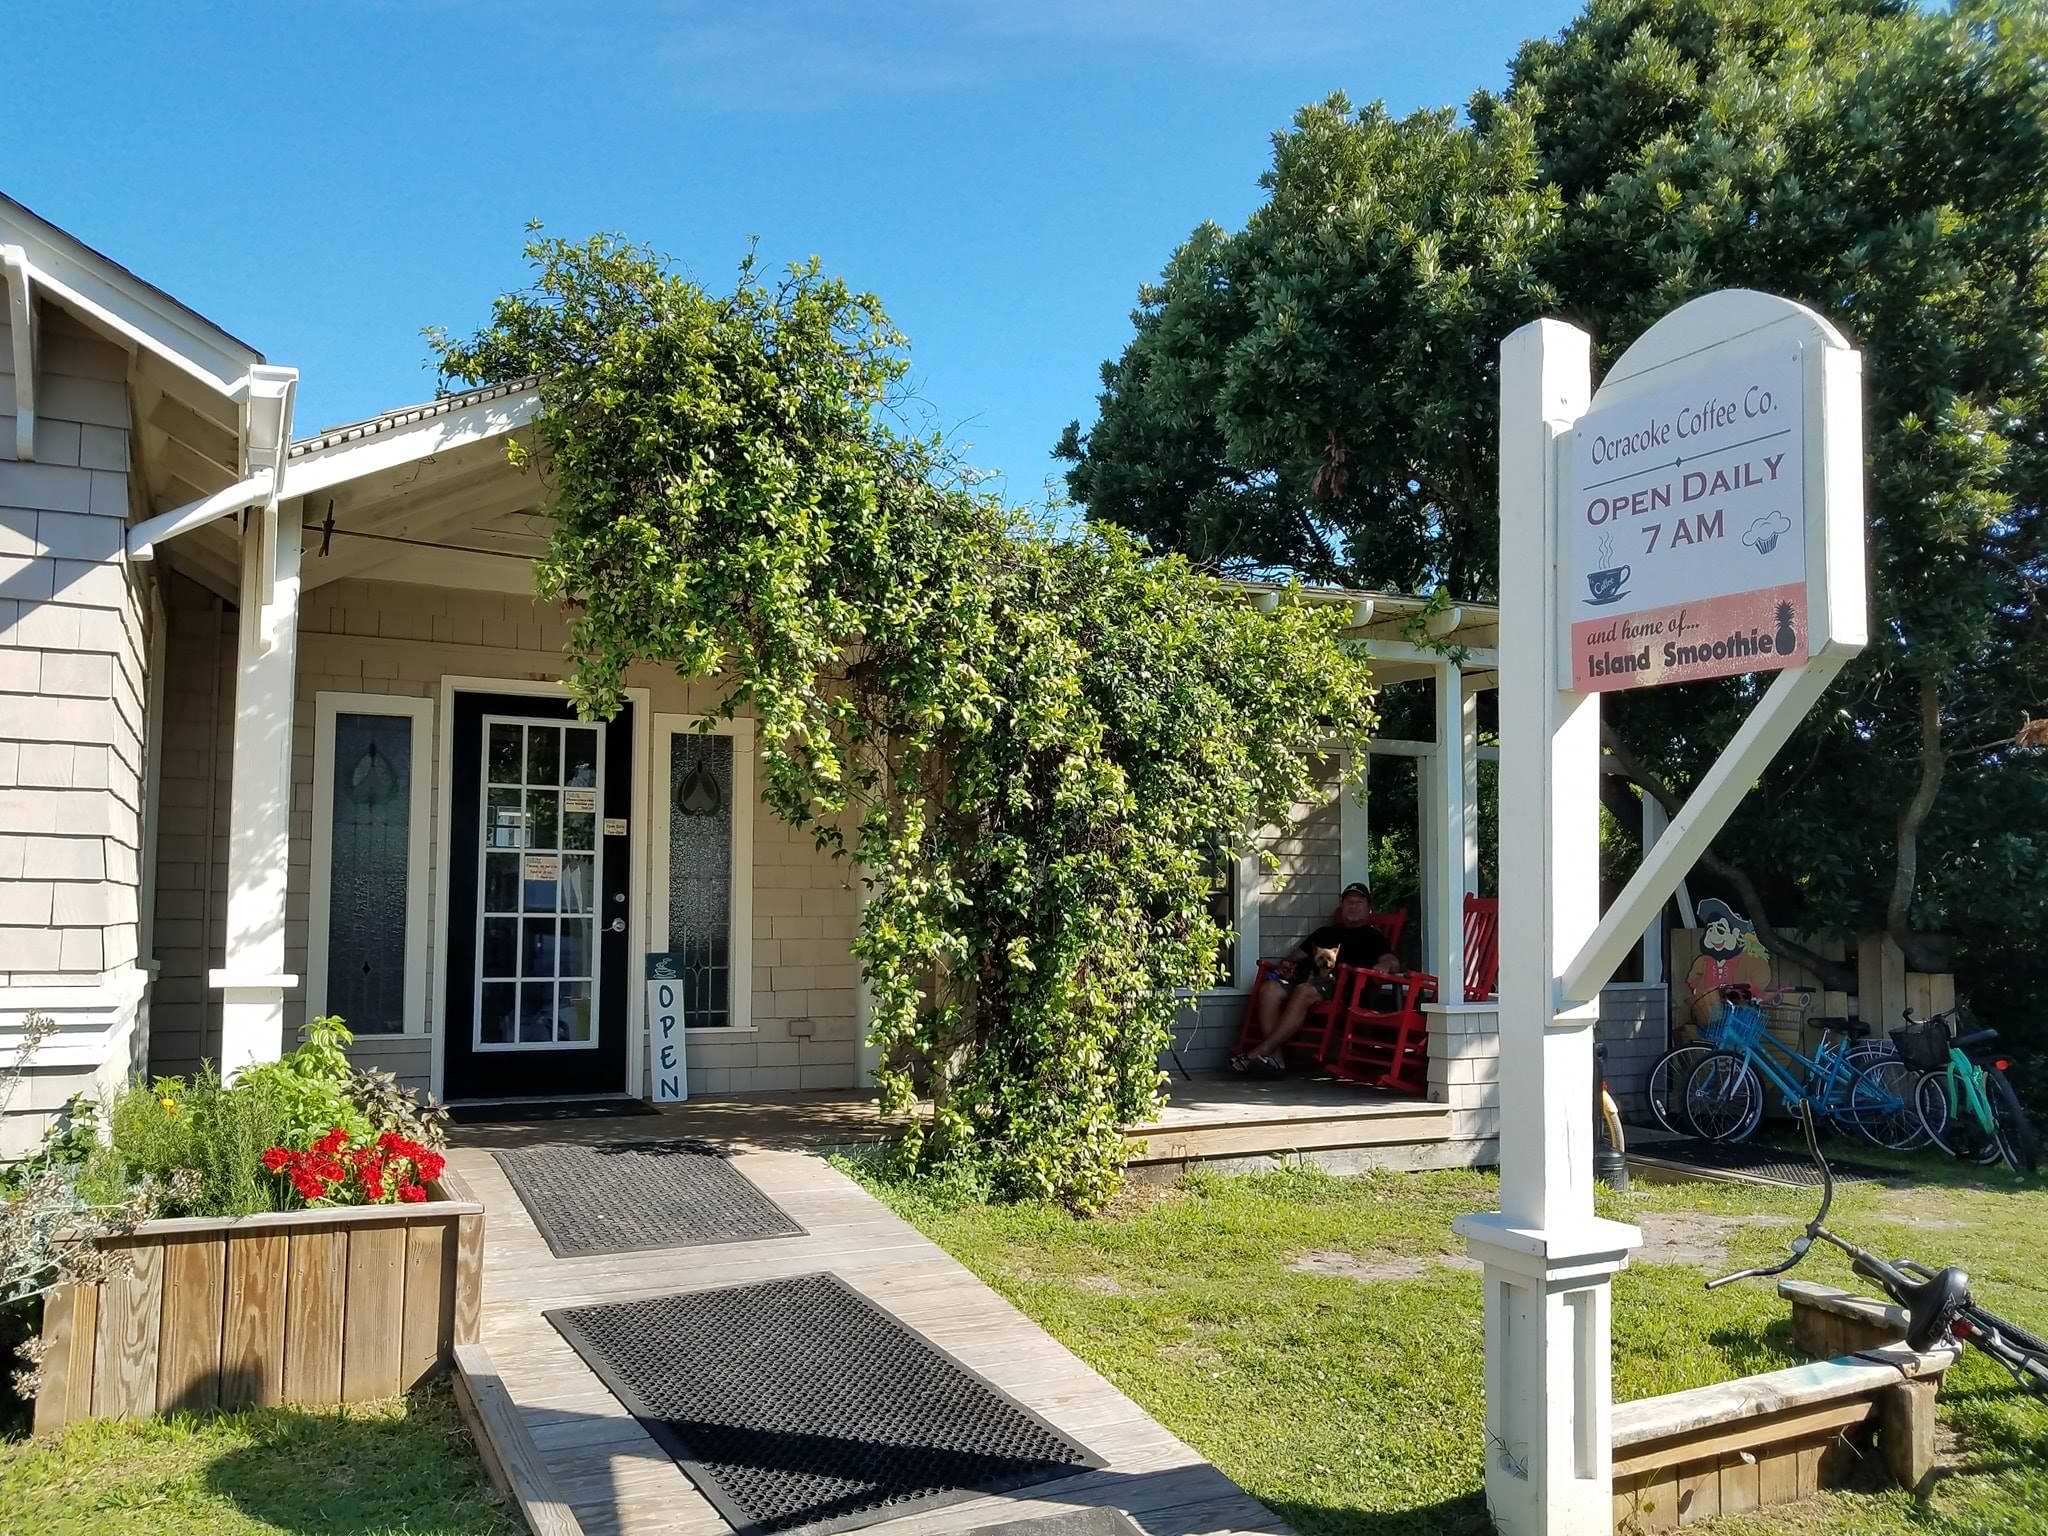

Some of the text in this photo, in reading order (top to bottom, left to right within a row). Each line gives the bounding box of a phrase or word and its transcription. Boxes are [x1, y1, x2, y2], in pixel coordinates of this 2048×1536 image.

[1592, 385, 1777, 465] Ocracoke Coffee Co.
[1587, 453, 1785, 525] OPEN DAILY
[1642, 509, 1724, 554] 7 AM
[1587, 622, 1616, 646] and
[1622, 617, 1664, 641] home
[1588, 628, 1773, 678] Island Smoothie
[658, 984, 679, 1099] OPEN
